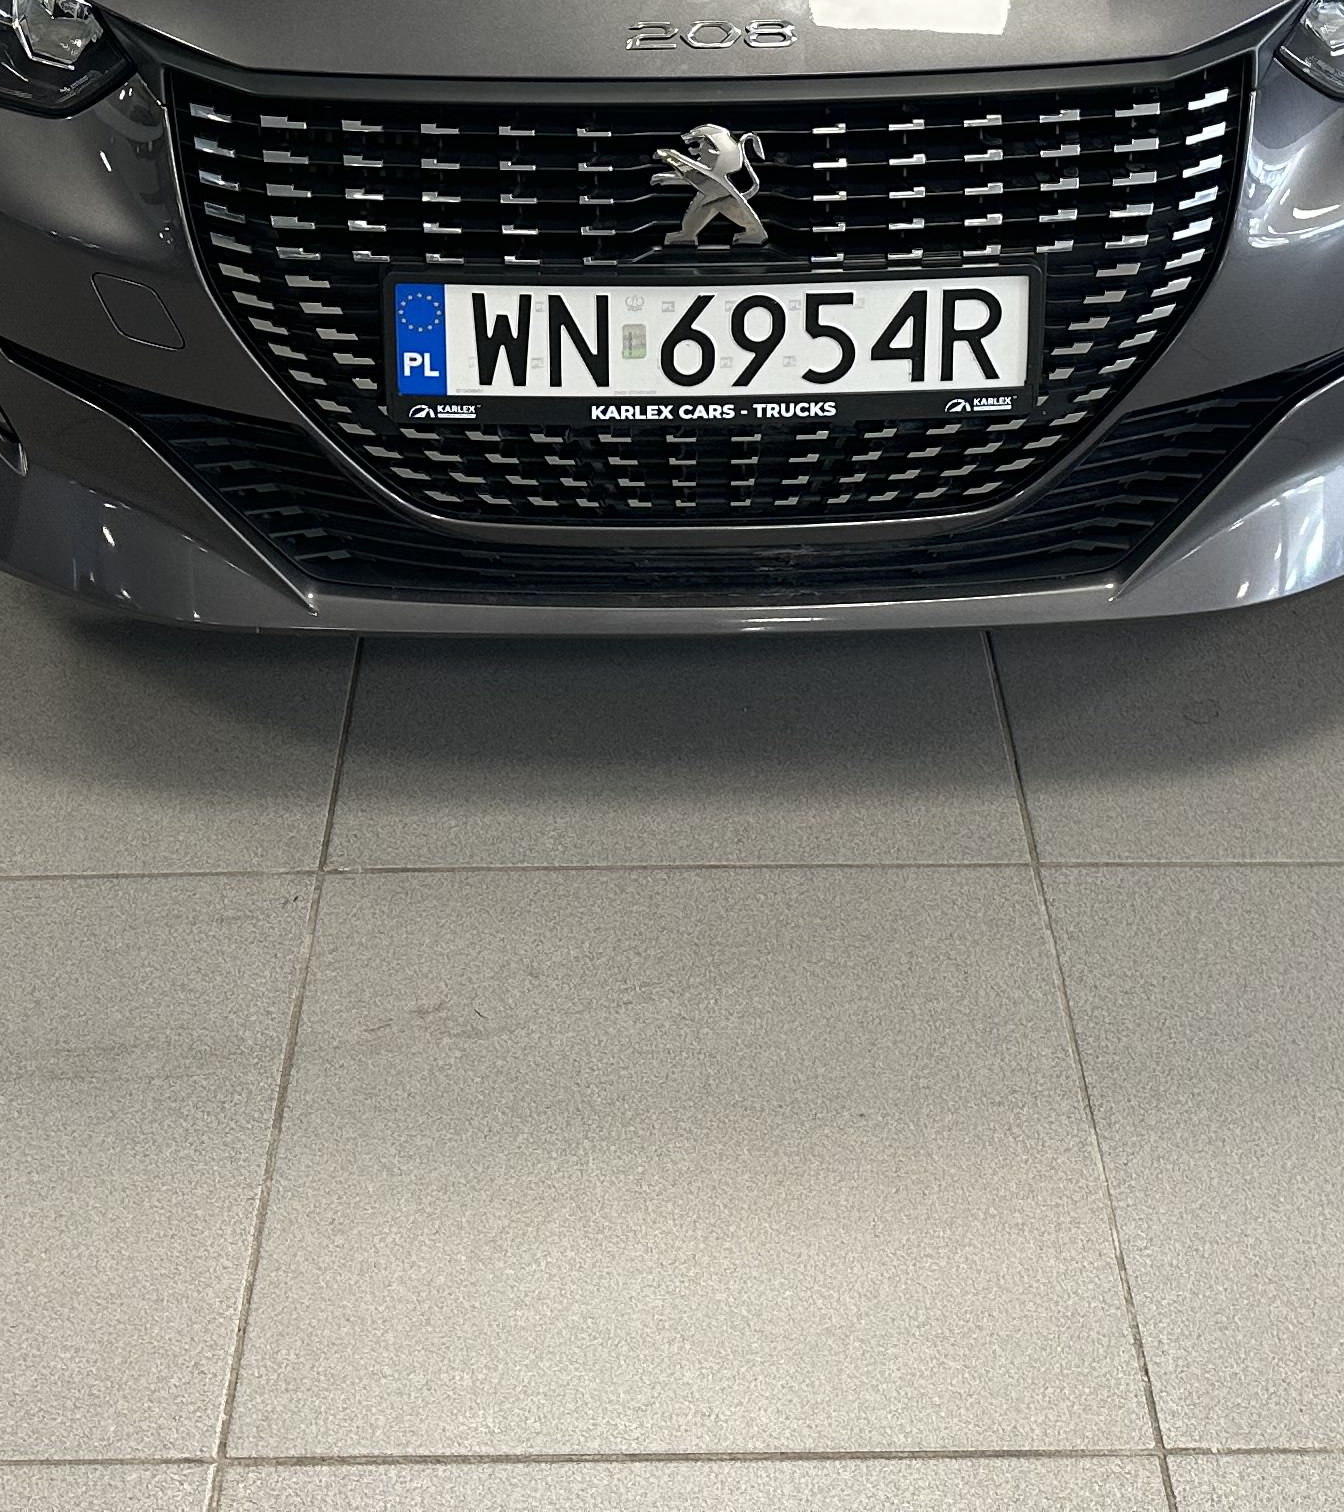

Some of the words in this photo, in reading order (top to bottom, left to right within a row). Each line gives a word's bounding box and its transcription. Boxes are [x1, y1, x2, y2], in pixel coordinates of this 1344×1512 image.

[624, 19, 798, 51] 208
[471, 291, 611, 388] WN
[659, 287, 1003, 387] 6954R
[403, 352, 440, 377] PL
[590, 404, 674, 421] KARLEX
[677, 403, 736, 420] CARS
[752, 401, 837, 419] TRUCKS
